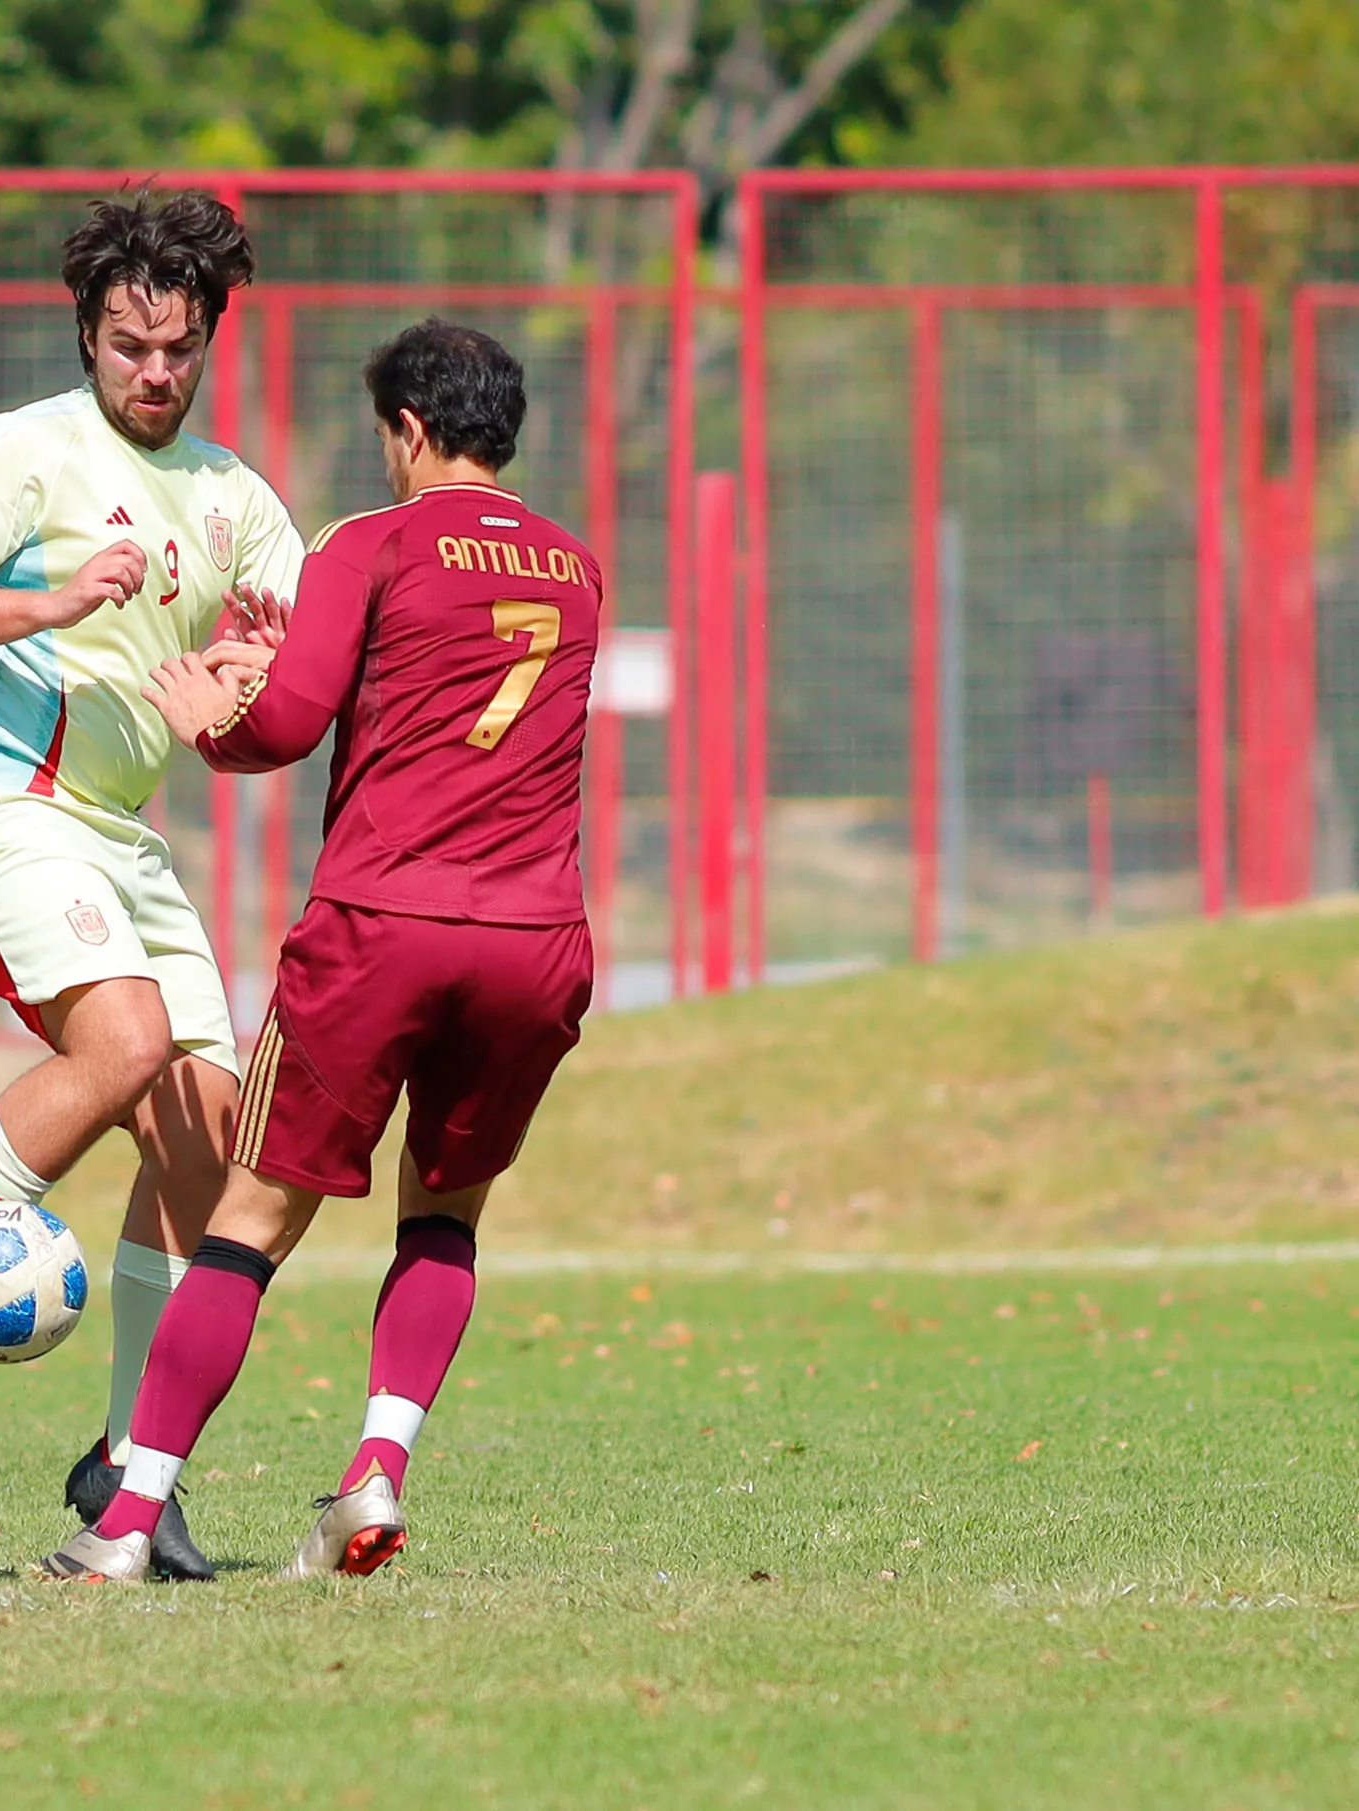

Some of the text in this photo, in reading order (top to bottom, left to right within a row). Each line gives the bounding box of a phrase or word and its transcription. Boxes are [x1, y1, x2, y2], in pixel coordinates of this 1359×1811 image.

[159, 539, 180, 606] 9
[436, 535, 589, 589] ANTILLON
[464, 599, 562, 752] 7
